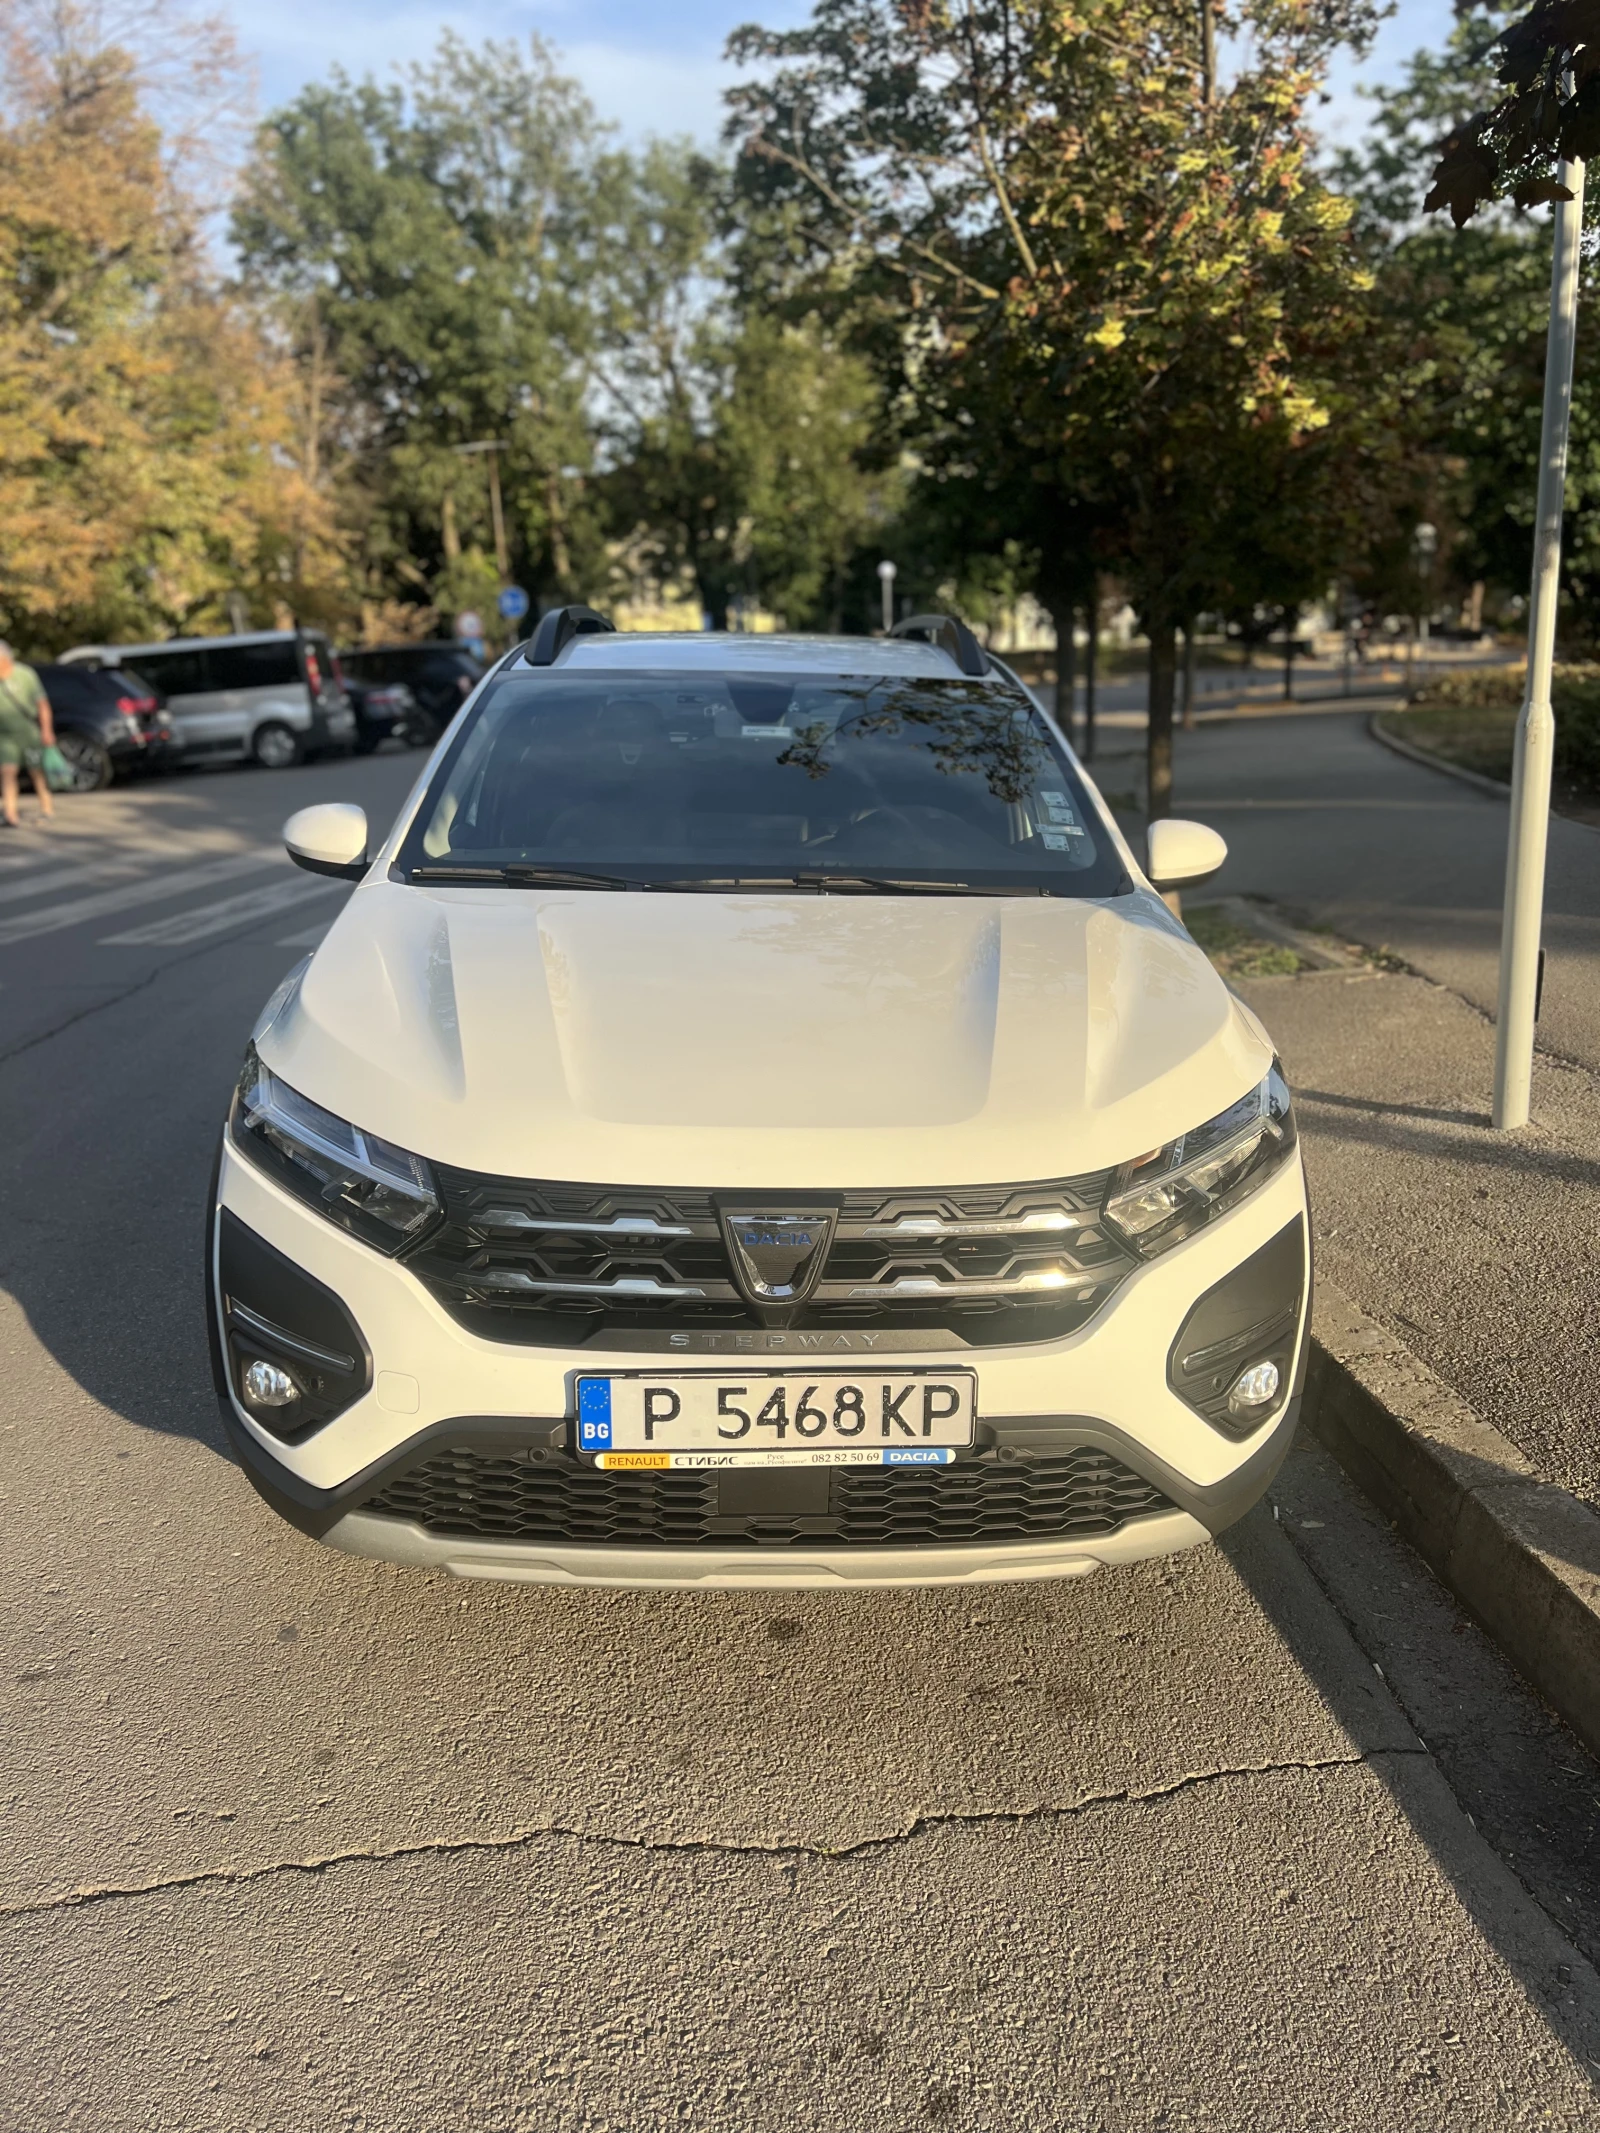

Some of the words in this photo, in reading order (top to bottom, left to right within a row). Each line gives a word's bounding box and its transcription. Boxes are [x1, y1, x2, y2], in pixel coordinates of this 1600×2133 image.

[743, 1232, 813, 1246] DACIA
[669, 1334, 880, 1348] STEPWAY
[643, 1387, 681, 1441] P
[717, 1385, 867, 1440] 5468
[881, 1384, 961, 1437] KP
[583, 1422, 609, 1440] BG
[608, 1457, 666, 1467] RENAULT
[674, 1456, 739, 1466] СТИБИС
[811, 1453, 831, 1464] 082
[834, 1453, 848, 1462] 82
[850, 1452, 864, 1462] 50
[866, 1452, 880, 1462] 69
[889, 1452, 940, 1462] DACIA
